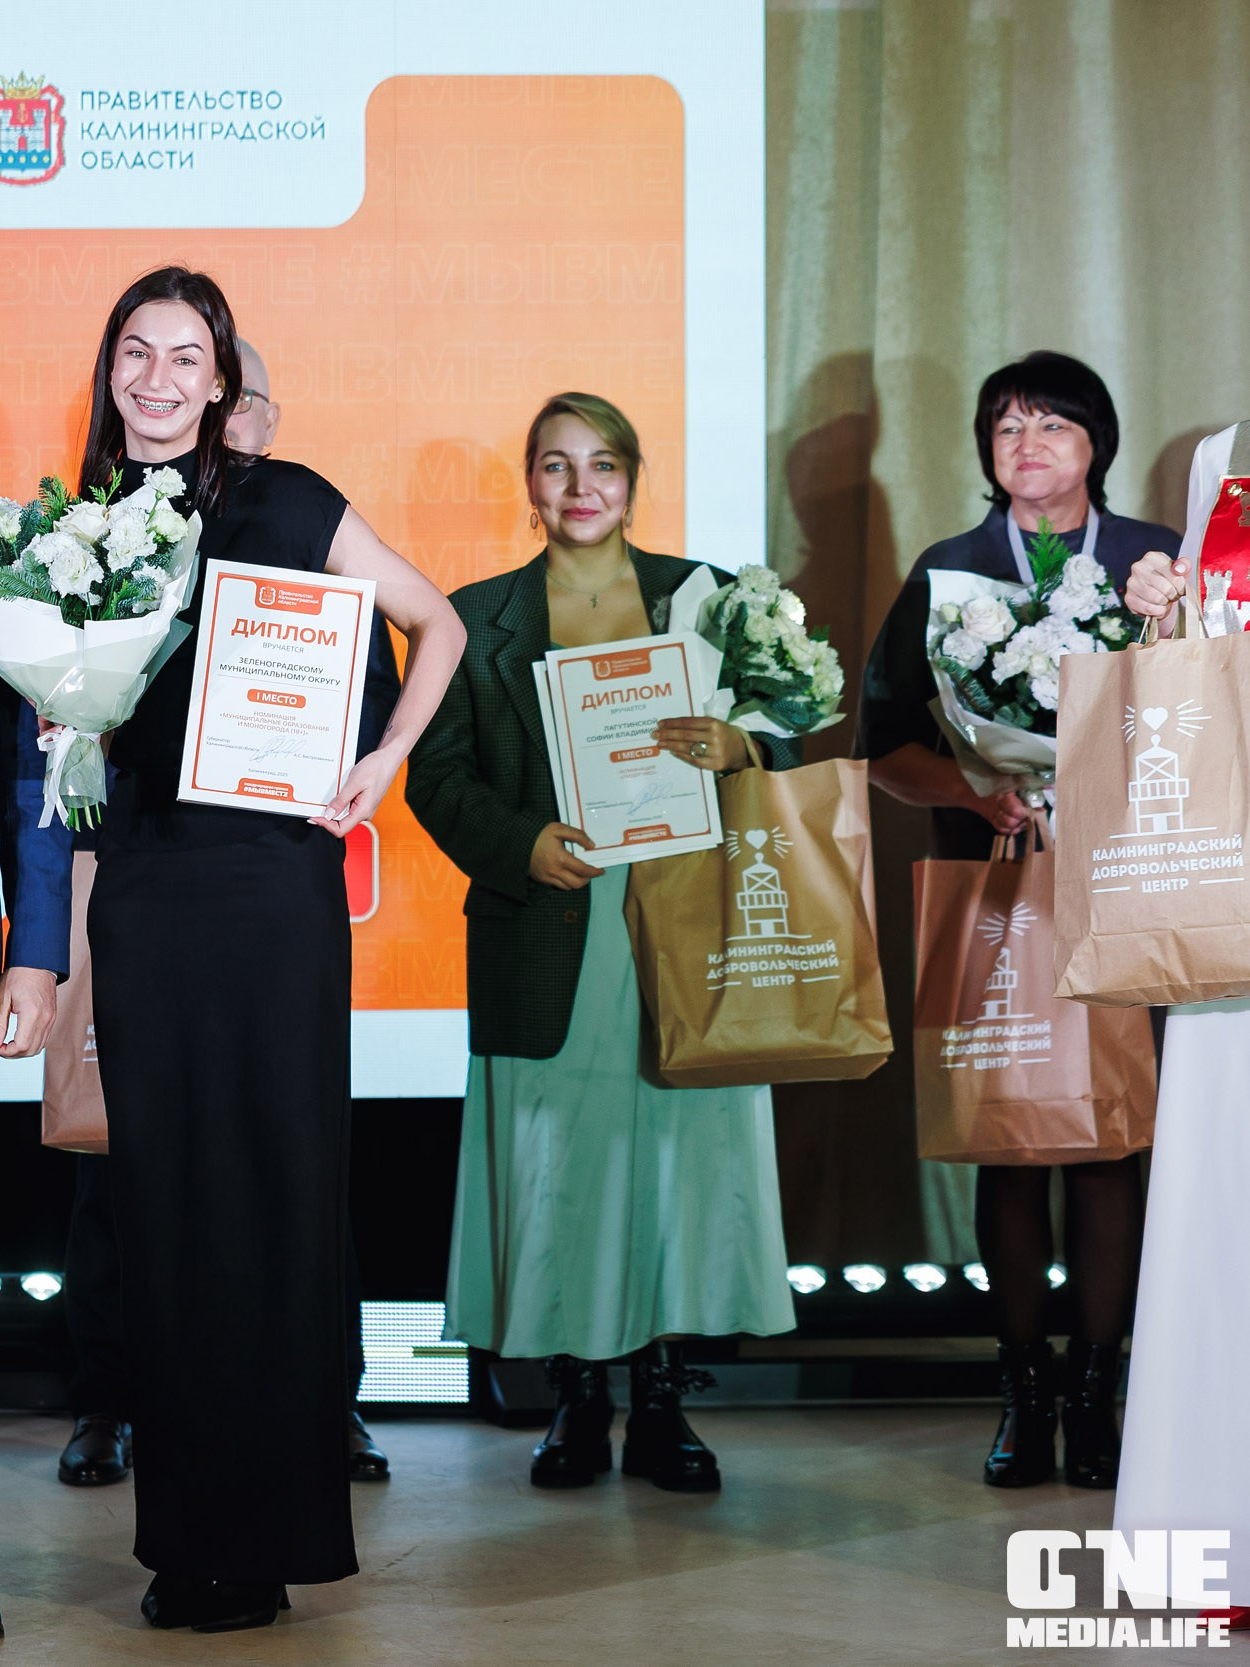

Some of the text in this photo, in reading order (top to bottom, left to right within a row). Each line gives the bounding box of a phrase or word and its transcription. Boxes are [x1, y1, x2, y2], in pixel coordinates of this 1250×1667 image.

[80, 90, 283, 111] ПРАВИТЕЛЬСТВО
[80, 115, 327, 142] КАЛИНИНГРАДСКОЙ
[80, 150, 195, 170] ОБЛАСТИ
[230, 618, 338, 647] ДИПЛОМ
[262, 642, 304, 653] ВРУЧАЕТСЯ
[238, 657, 324, 675] ЗЕЛЕНОГРАДСКОМУ
[219, 664, 341, 687] МУНИЦИПАЛЬНОМУ ОКРУГУ
[261, 693, 297, 705] МЕСТО
[581, 682, 672, 712] ДИПЛОМ
[253, 711, 296, 721] НОМИНАЦИЯ
[610, 704, 647, 715] ВРУЧАЕТСЯ
[242, 721, 290, 733] МОНОГОРОДА
[282, 720, 330, 732] ОБРАЗОВАНИЯ
[586, 727, 655, 743] СОФИИ ВЛАДИМИ
[621, 748, 653, 759] МЕСТО
[1092, 833, 1243, 862] КАЛИНИНГРАДСКИЙ
[1091, 852, 1244, 881] ДОБРОВОЛЬЧЕСКИЙ
[1141, 878, 1190, 894] ЦЕНТР
[751, 974, 796, 988] ЦЕНТР
[973, 1056, 1011, 1070] ЦЕНТР
